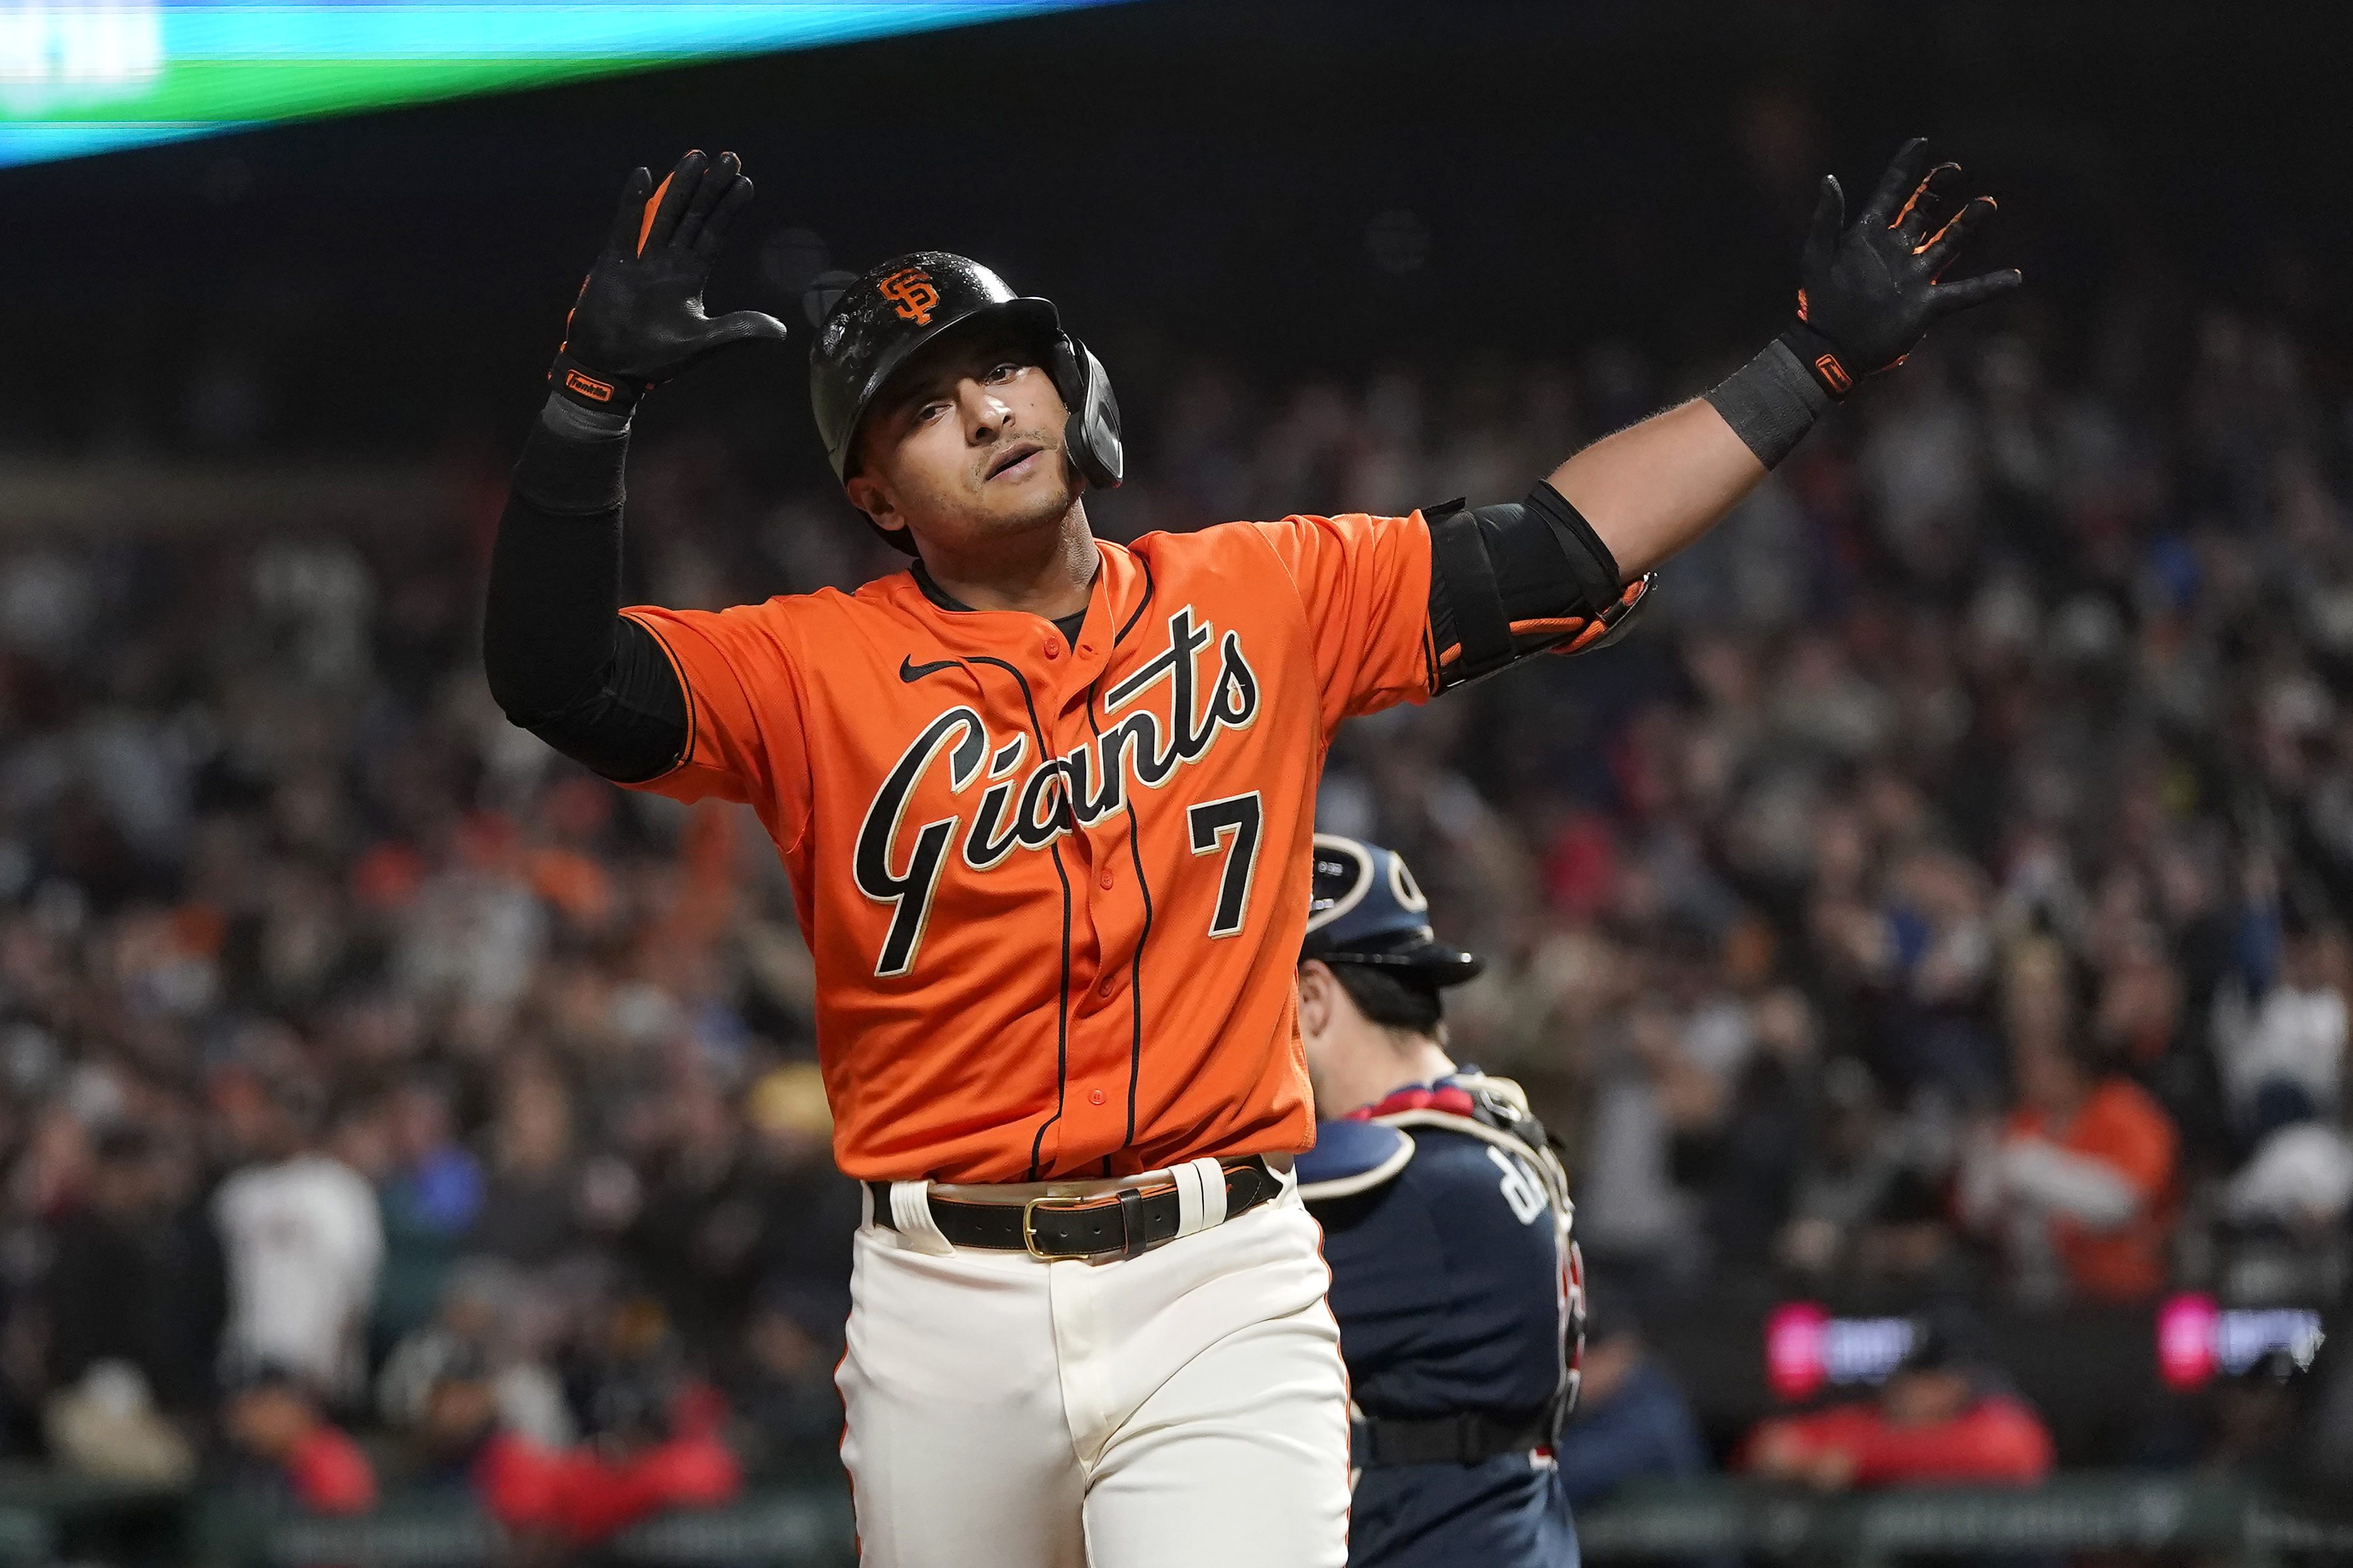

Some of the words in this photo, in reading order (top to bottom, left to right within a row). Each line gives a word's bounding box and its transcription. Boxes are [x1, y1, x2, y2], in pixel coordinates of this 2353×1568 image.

[879, 268, 940, 327] SF
[853, 604, 1262, 978] Giants
[1187, 789, 1265, 939] 7
